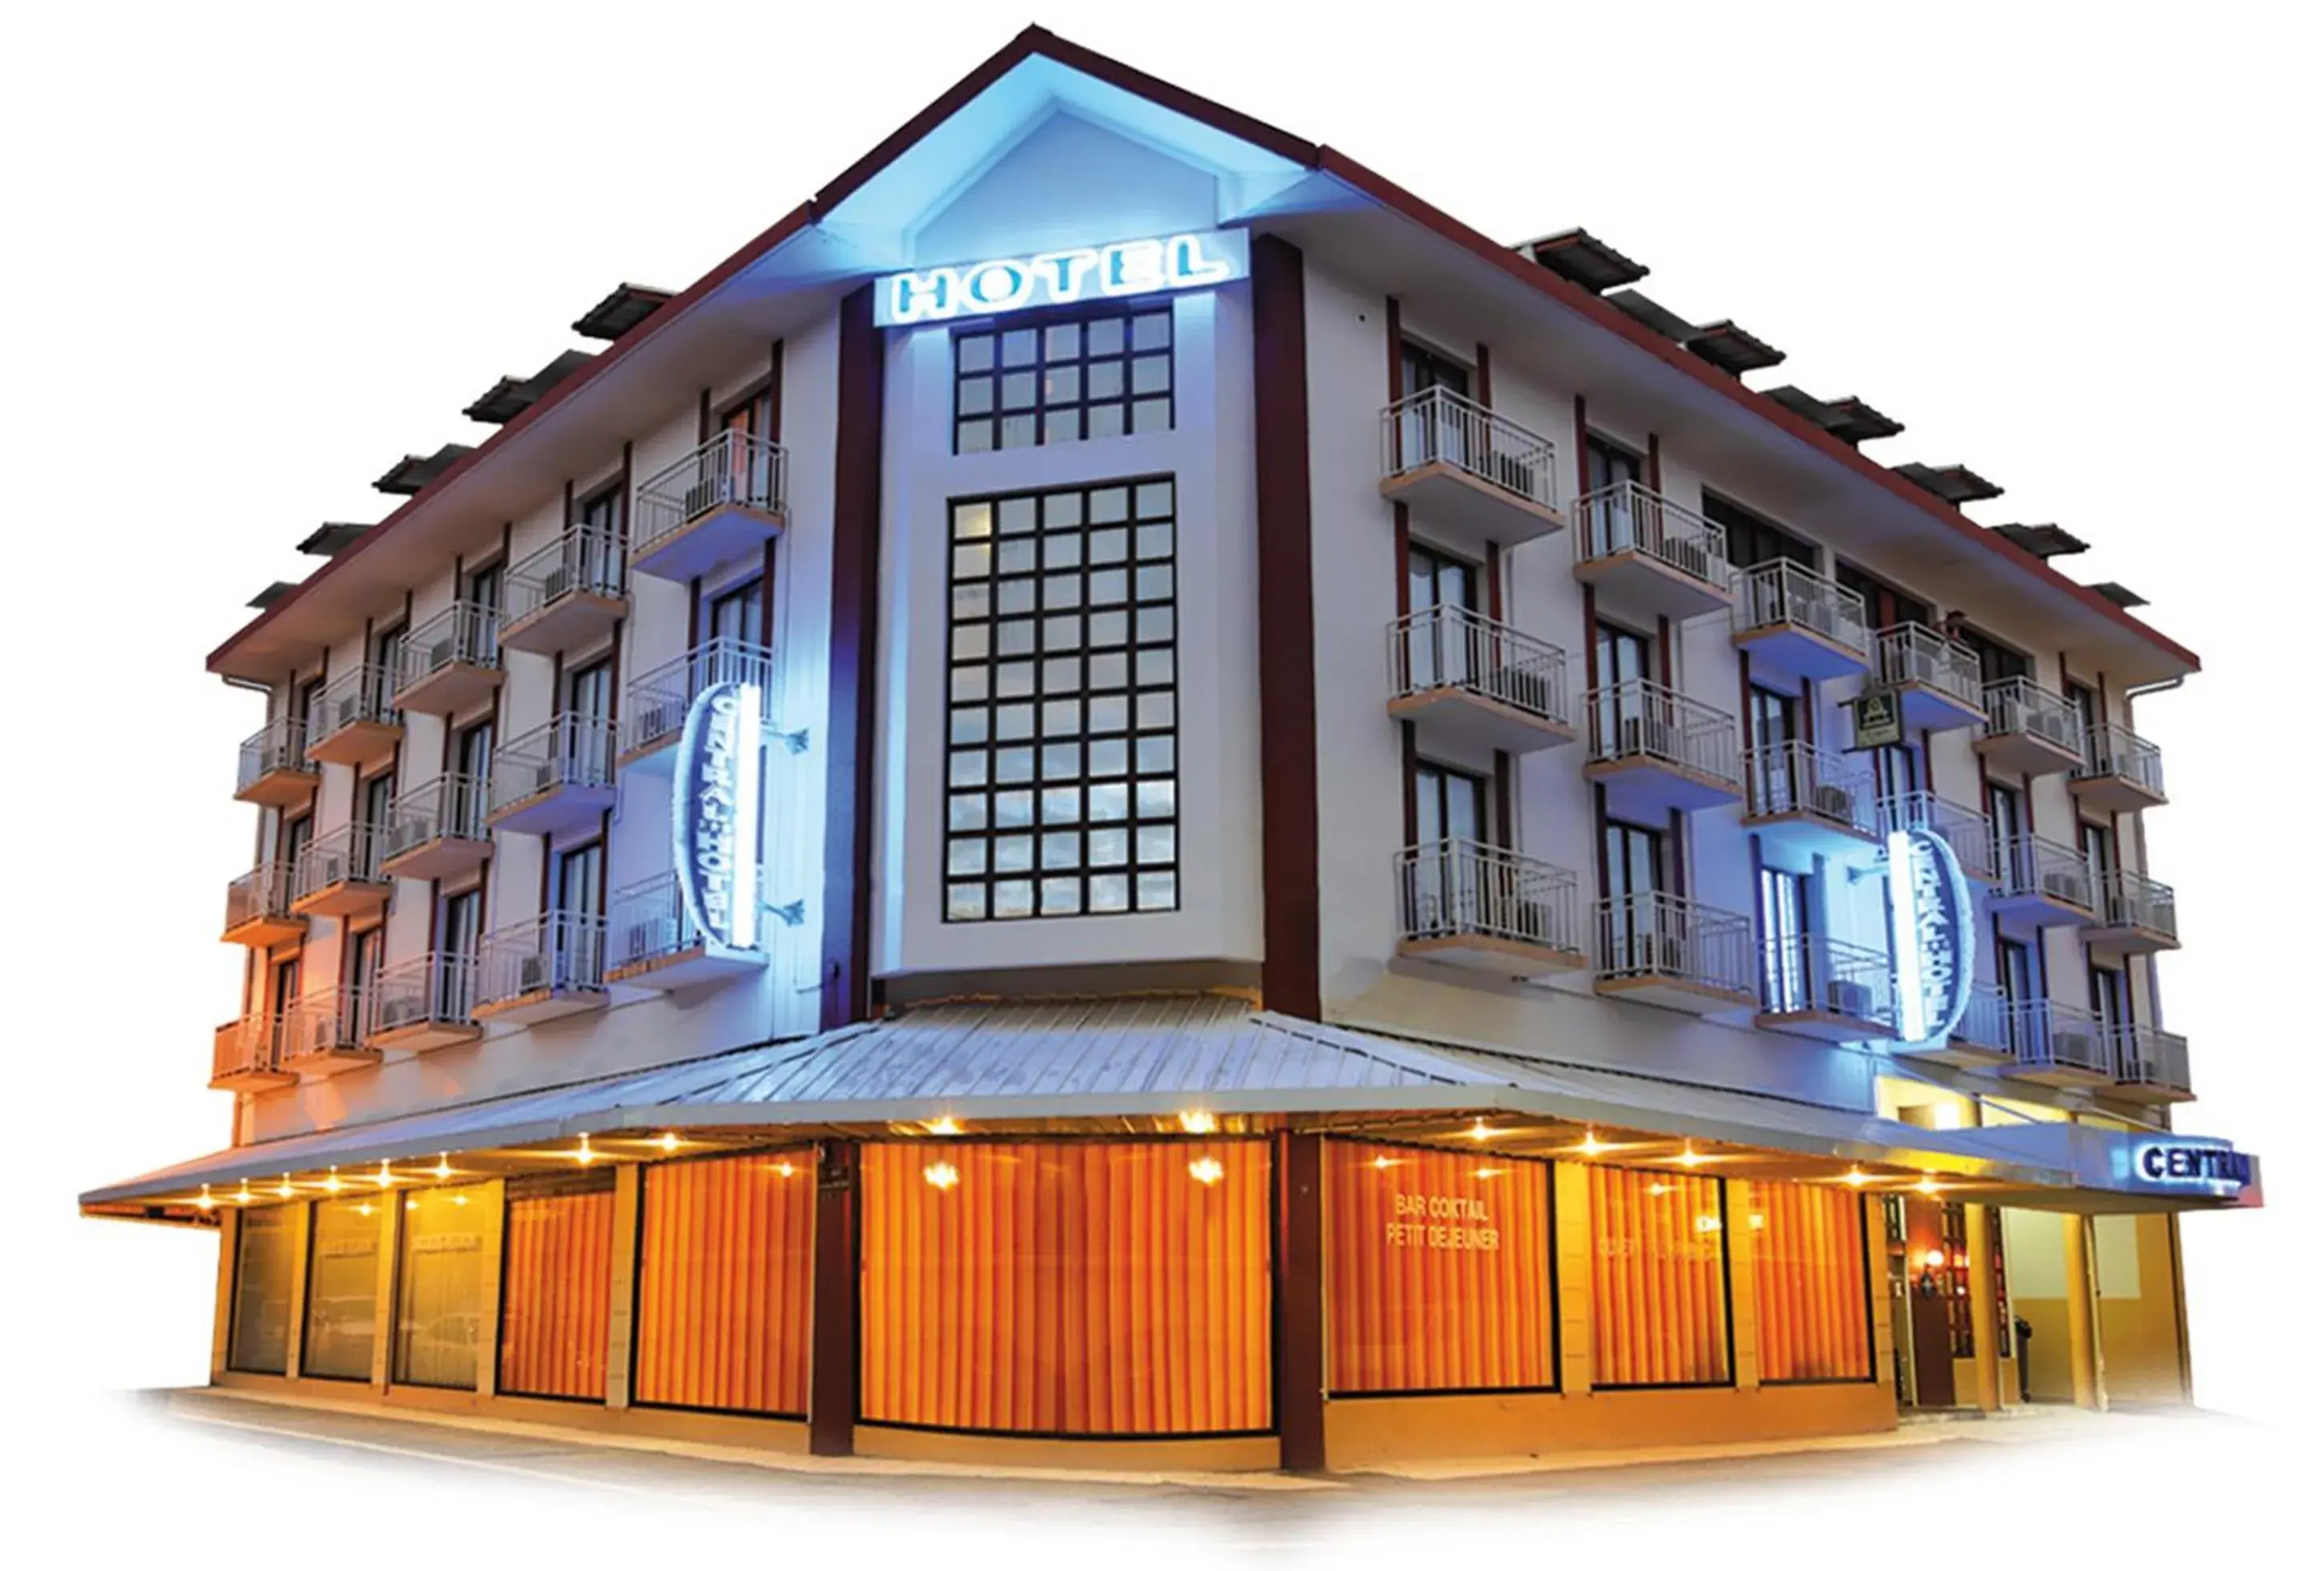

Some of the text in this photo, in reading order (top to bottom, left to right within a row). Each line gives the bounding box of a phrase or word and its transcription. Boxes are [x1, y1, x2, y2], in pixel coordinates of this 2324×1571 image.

[892, 234, 1229, 321] HOTEL
[1395, 1193, 1426, 1216] BAR
[1386, 1222, 1426, 1246] PETIT
